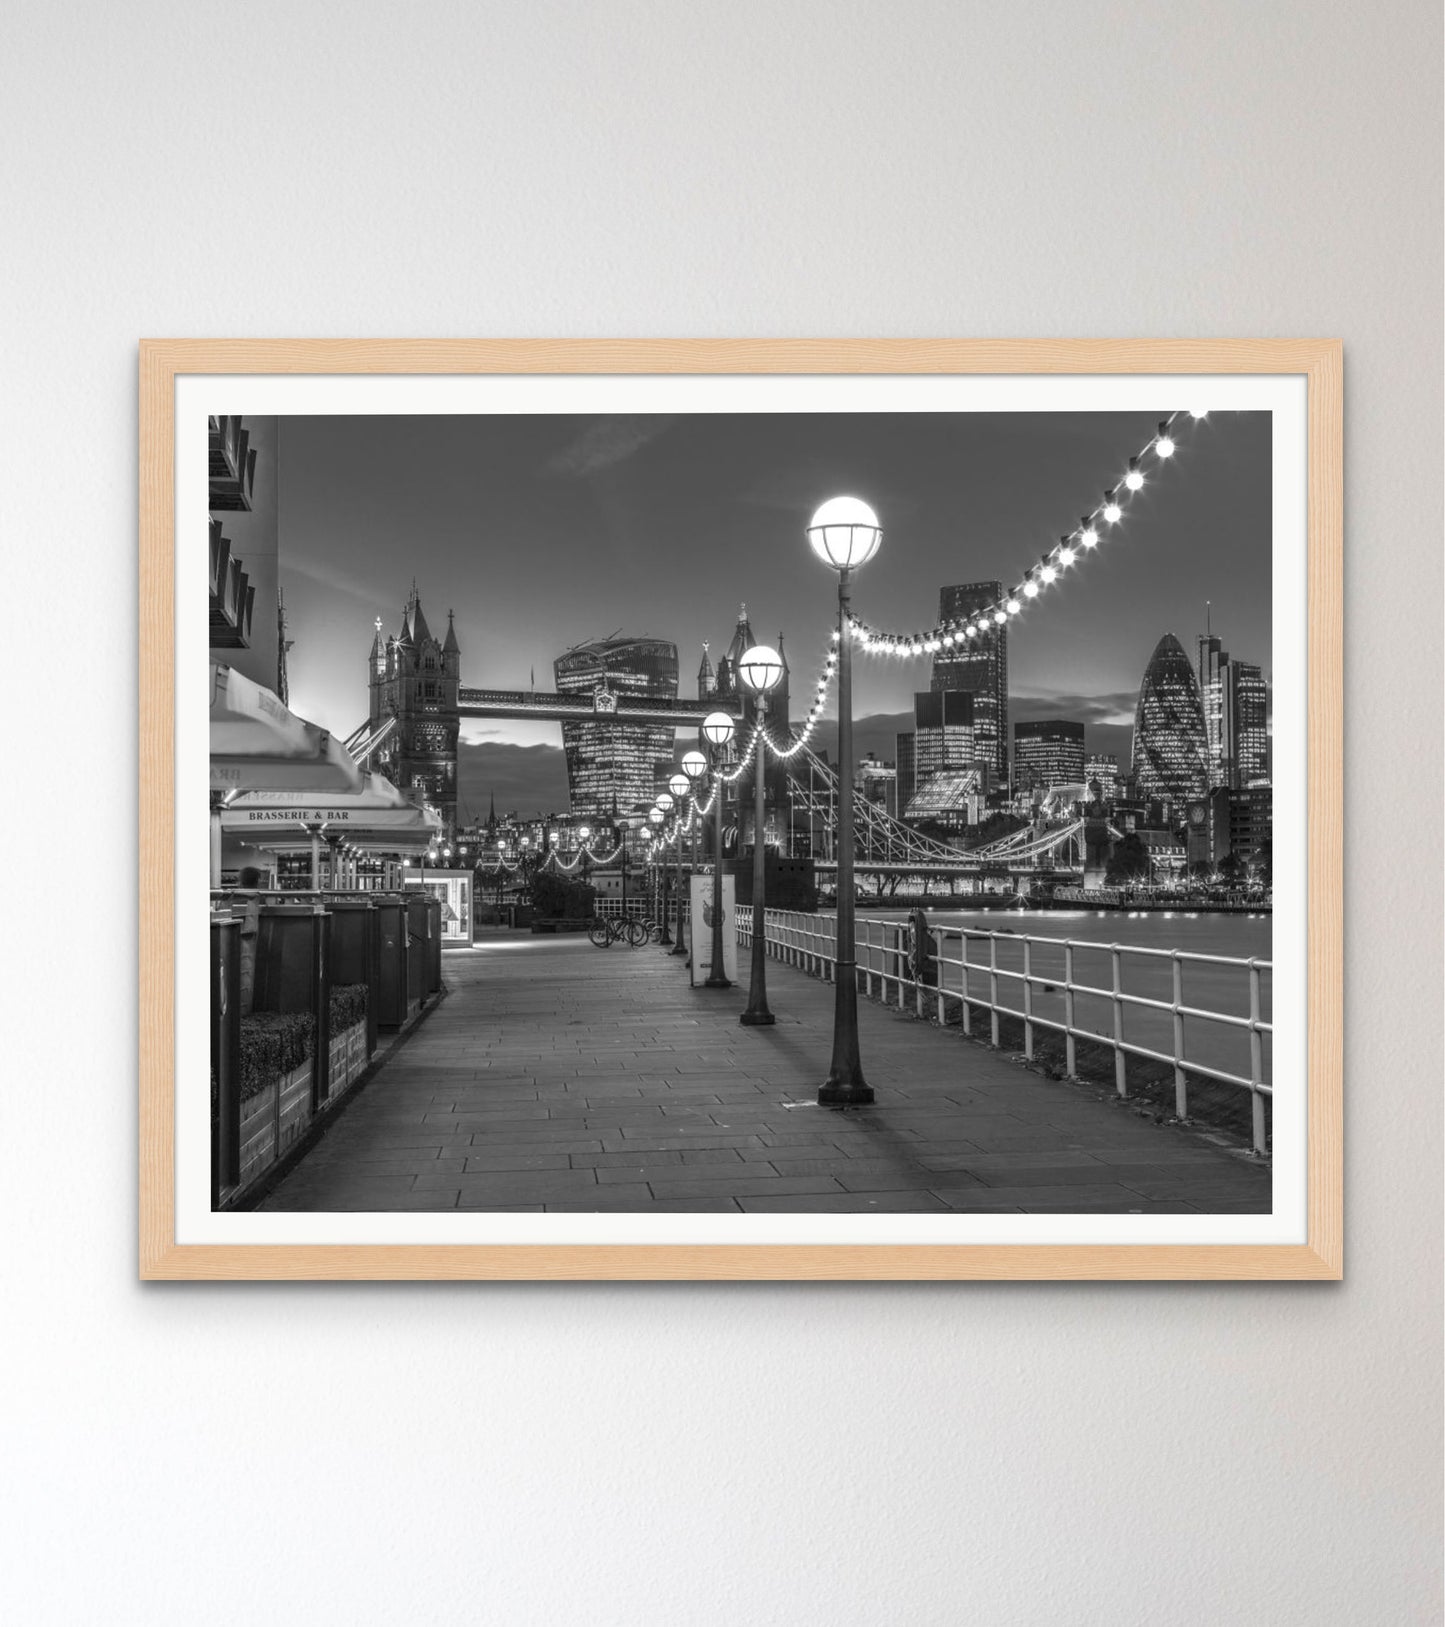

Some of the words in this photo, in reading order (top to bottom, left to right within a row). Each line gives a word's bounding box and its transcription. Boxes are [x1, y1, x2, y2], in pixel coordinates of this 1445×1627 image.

[249, 811, 309, 820] BRASSERIE
[314, 811, 323, 820] &
[327, 811, 349, 820] BAR
